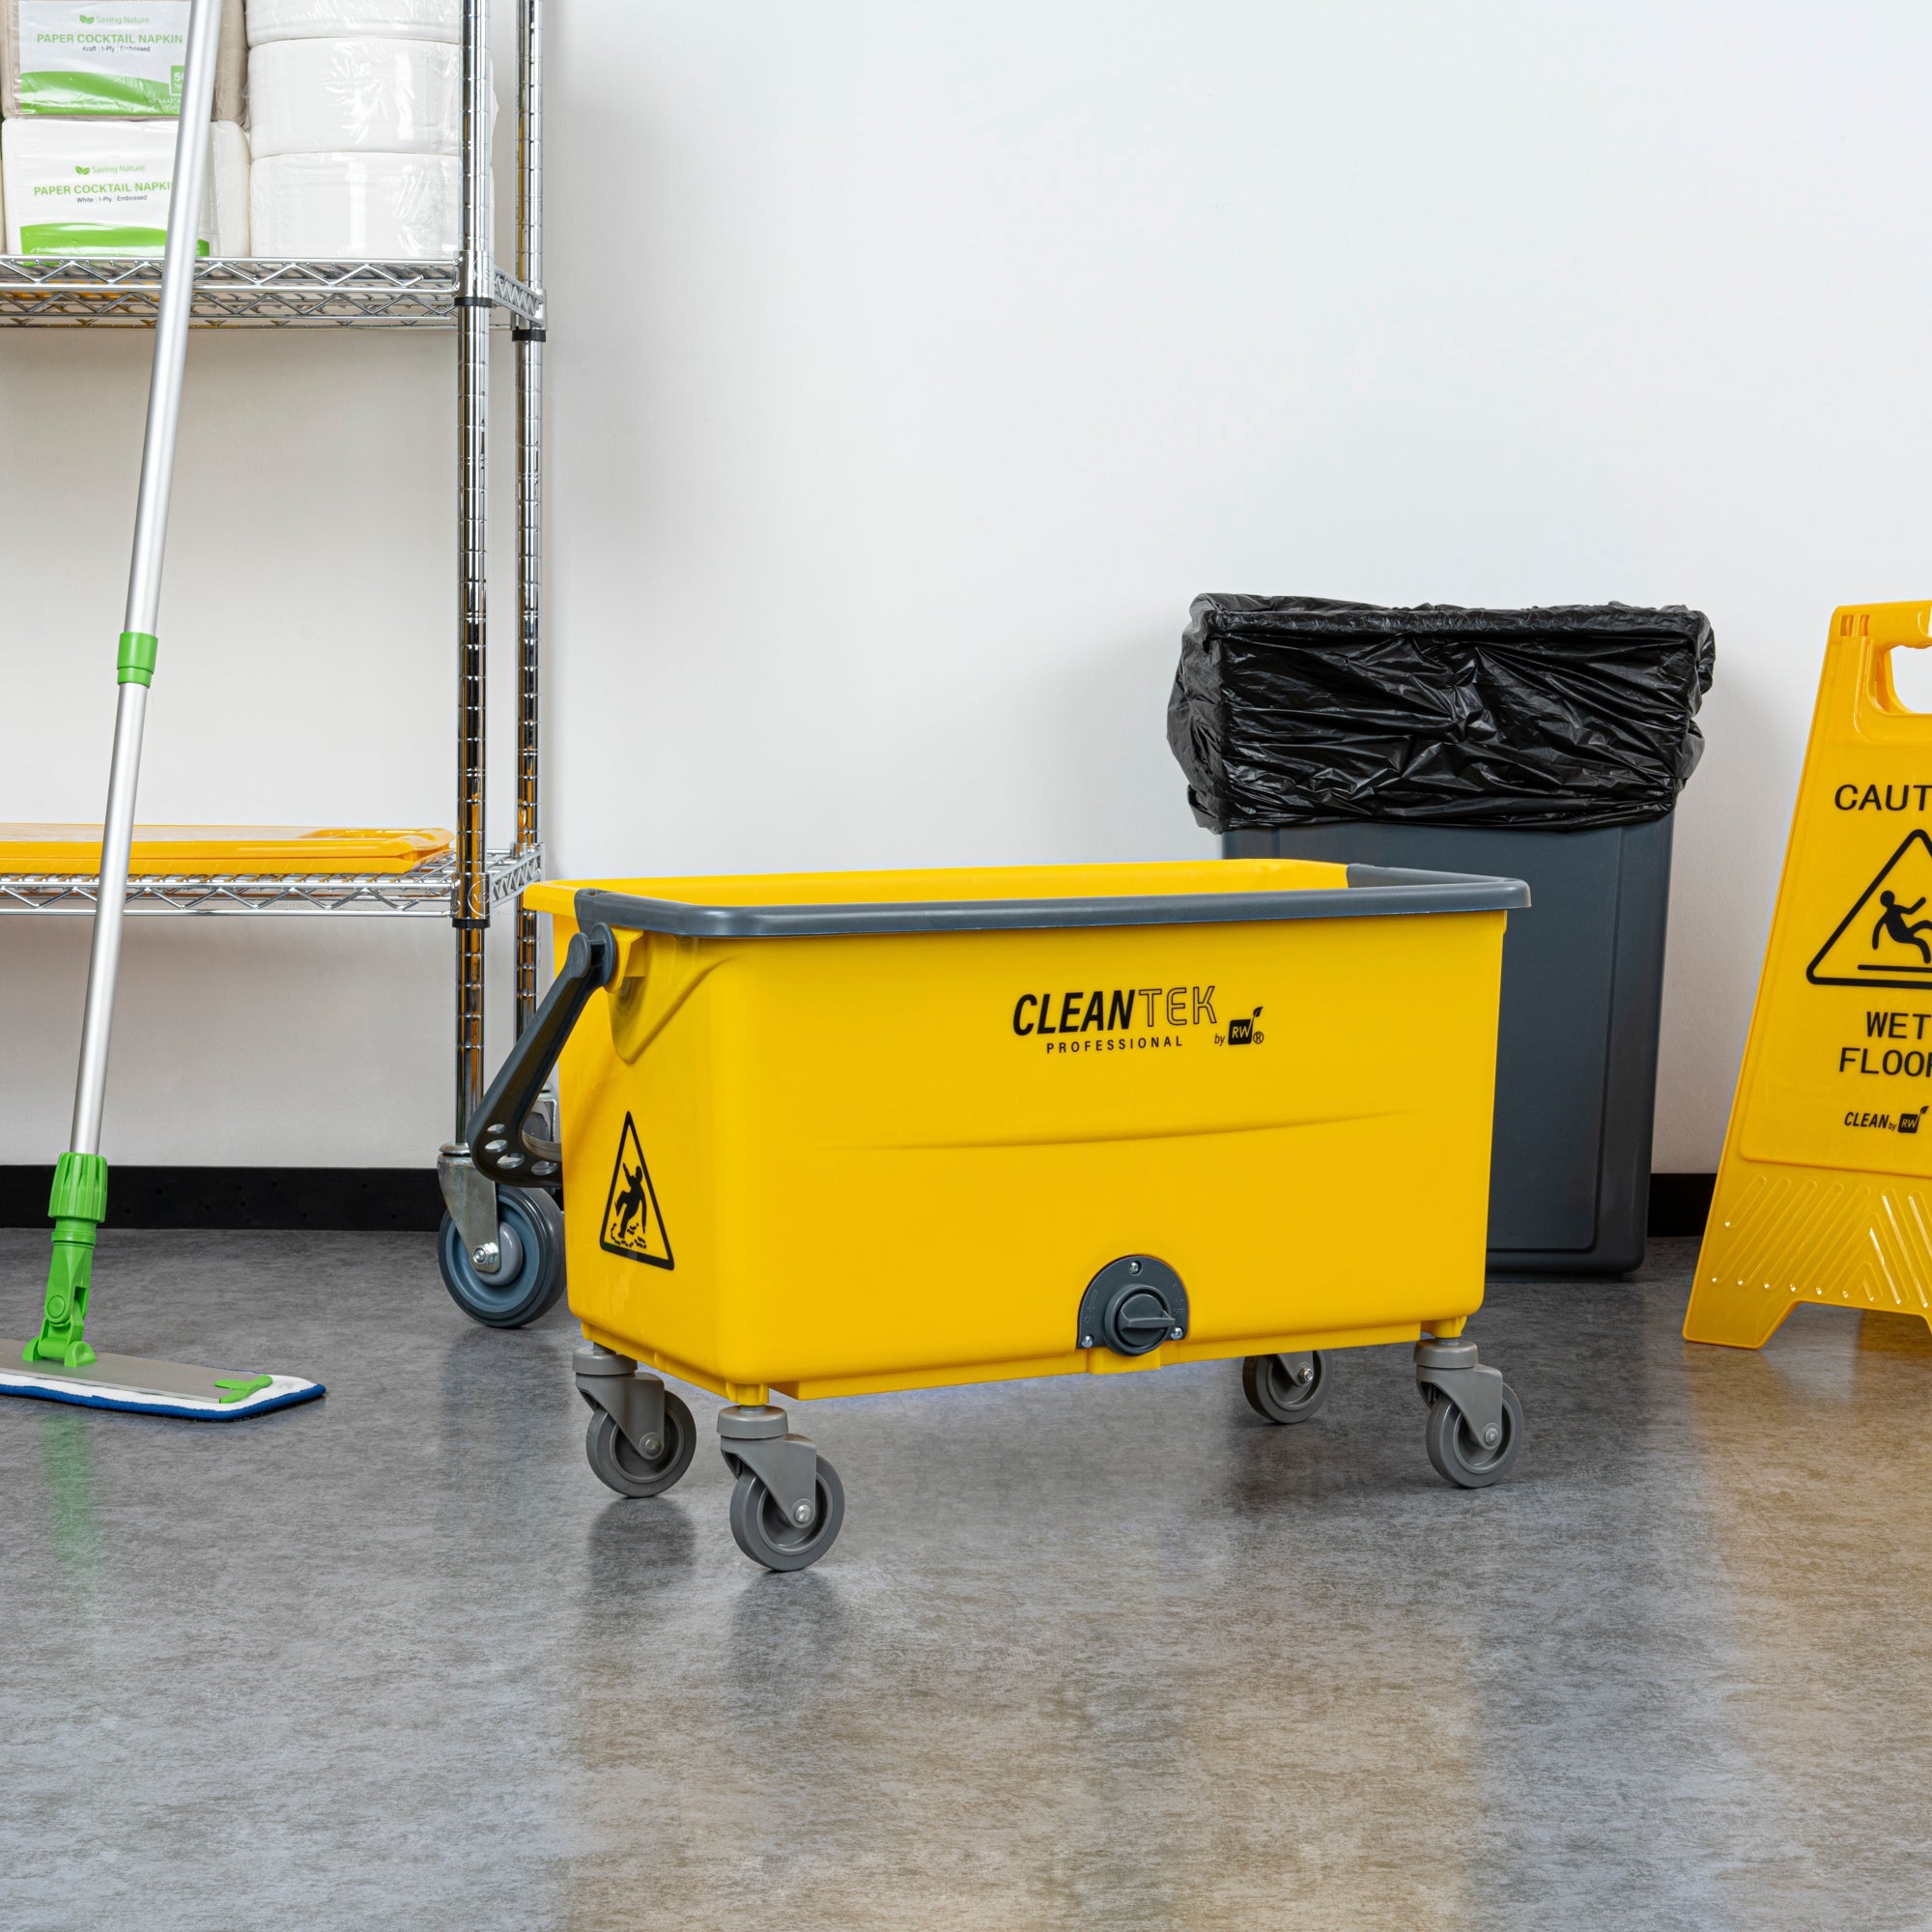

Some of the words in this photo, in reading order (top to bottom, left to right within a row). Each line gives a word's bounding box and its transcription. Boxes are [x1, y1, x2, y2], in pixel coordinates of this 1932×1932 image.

[96, 15, 122, 24] Saving
[37, 34, 73, 43] PAPER
[77, 34, 135, 43] COCKTAIL
[138, 34, 183, 44] NAPKIN
[34, 185, 71, 195] PAPER
[73, 184, 131, 194] COCKTAIL
[134, 181, 172, 191] NAPKI
[1013, 985, 1217, 1037] CLEANTEK
[1866, 1011, 1932, 1039] WET
[1046, 1036, 1182, 1054] PROFESSIONAL
[1214, 1034, 1226, 1047] by
[1844, 1112, 1889, 1129] CLEAN
[1888, 1122, 1896, 1131] by
